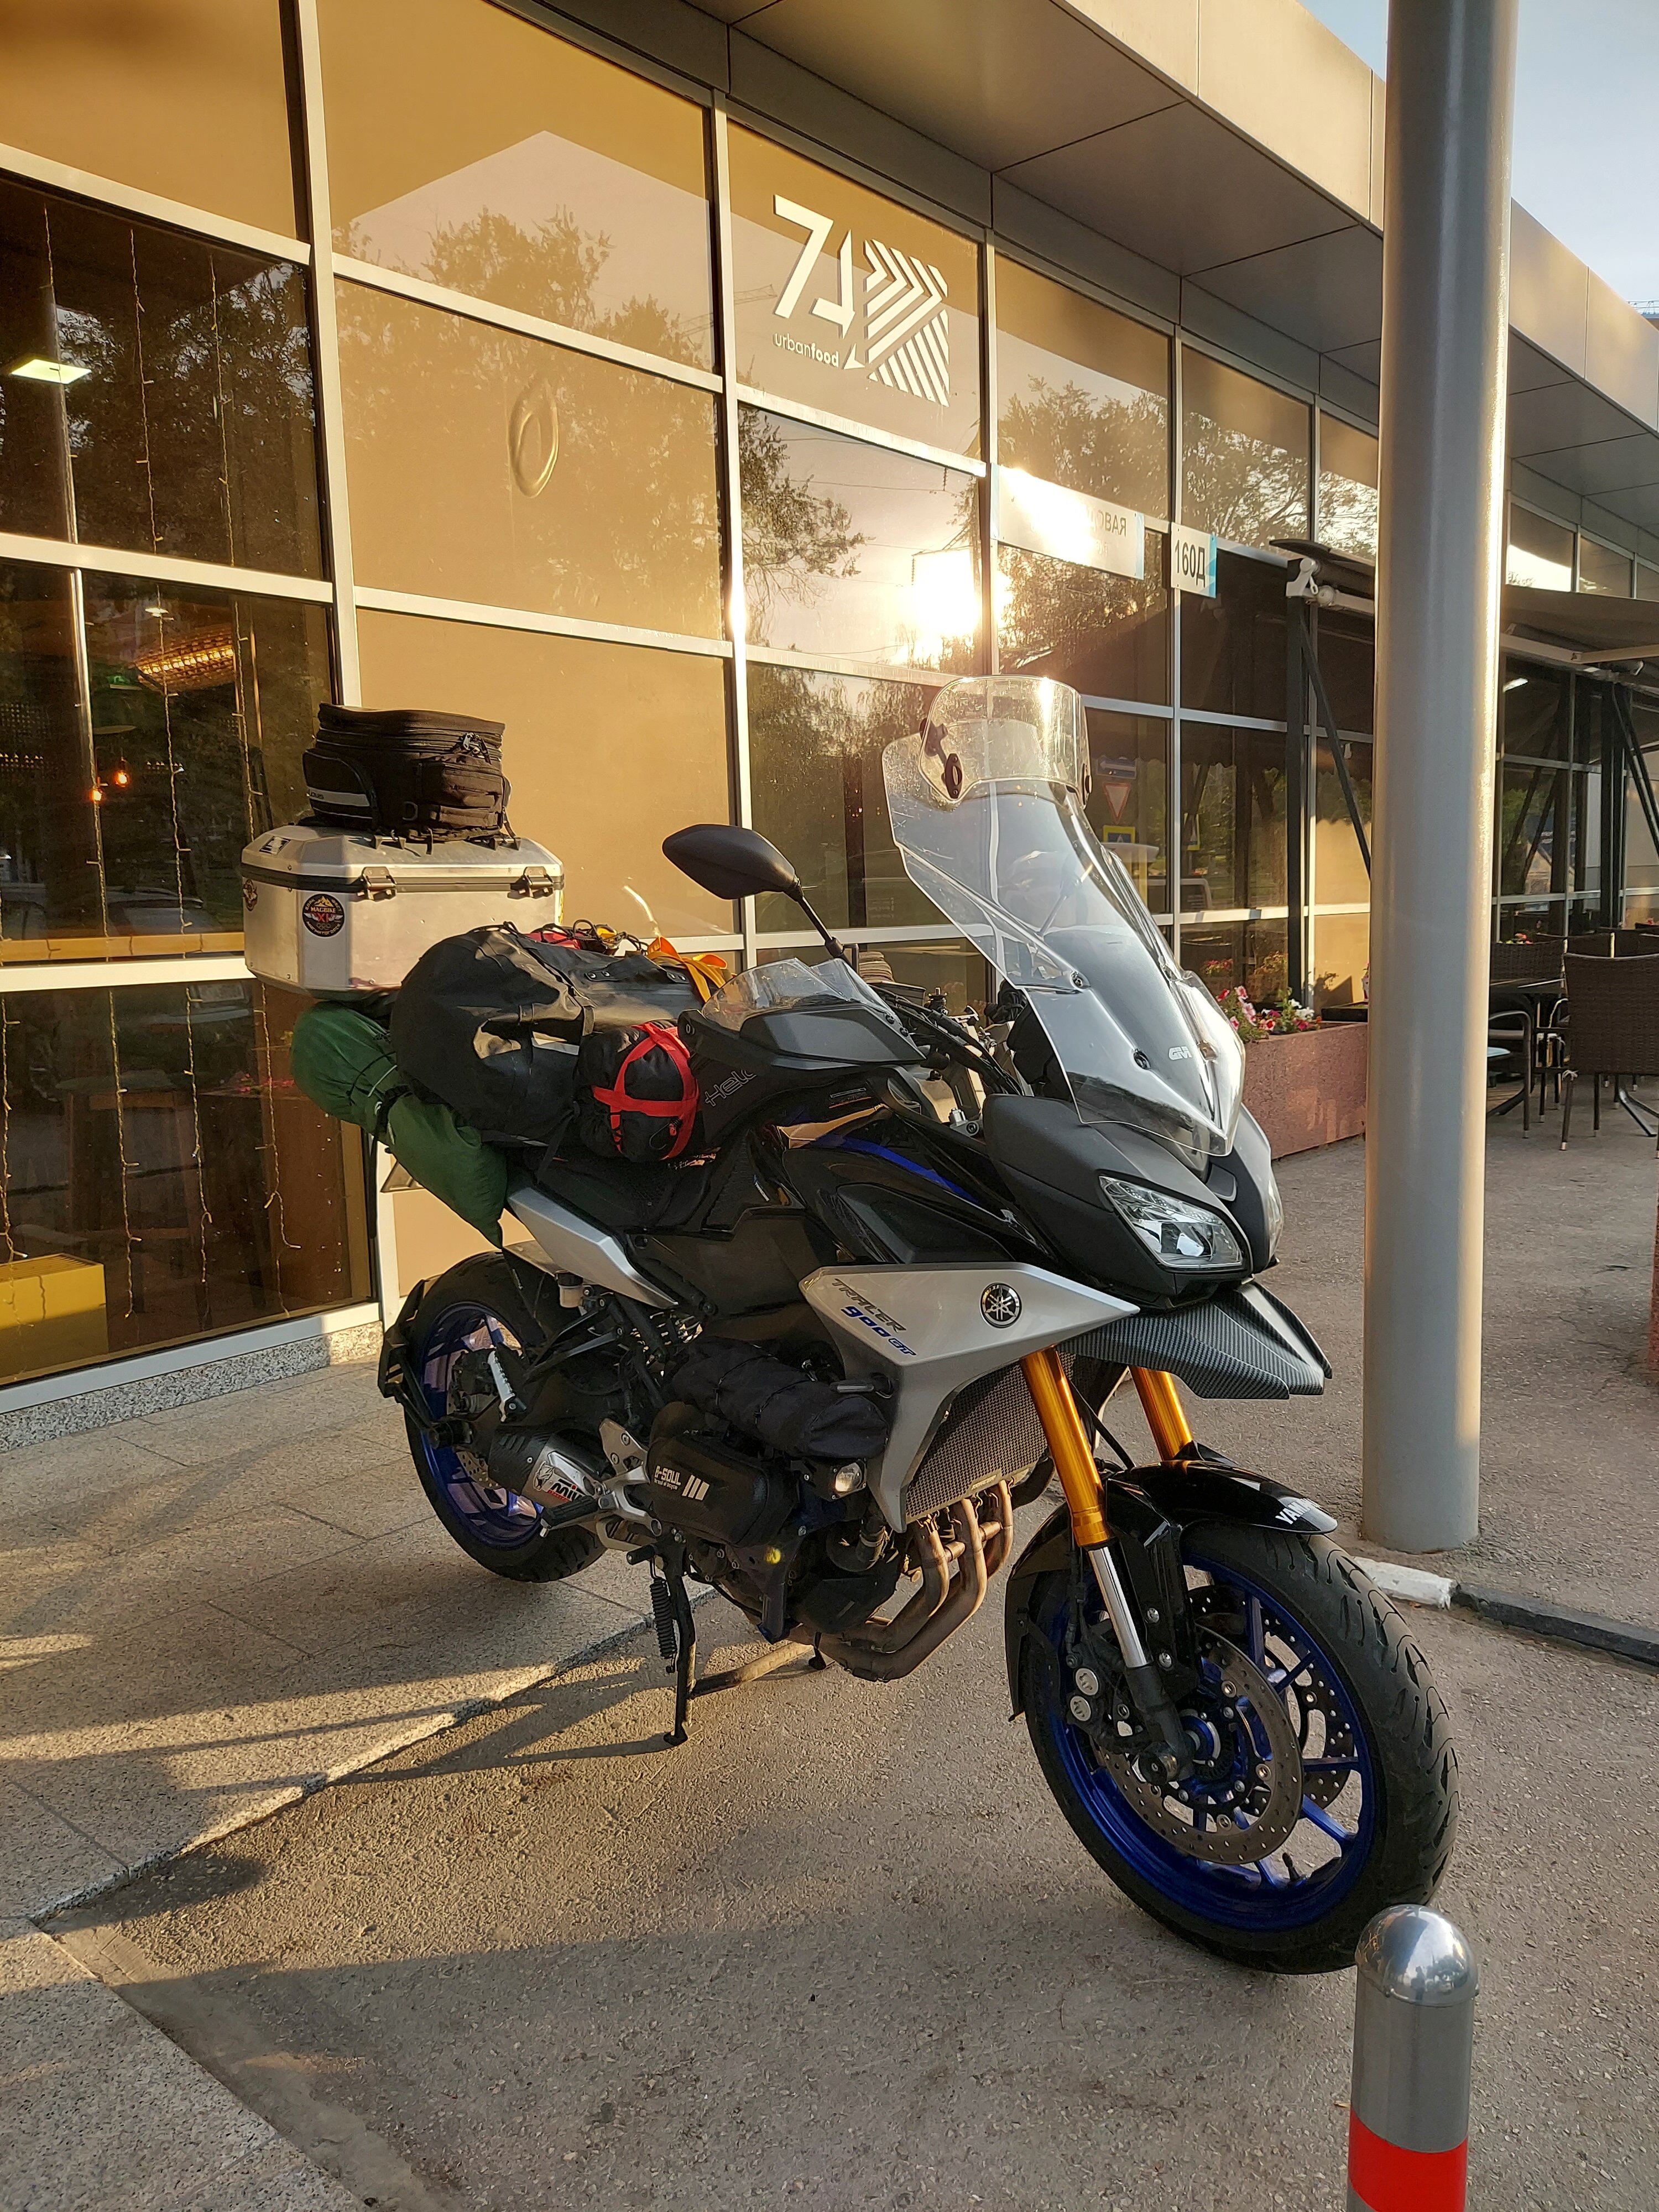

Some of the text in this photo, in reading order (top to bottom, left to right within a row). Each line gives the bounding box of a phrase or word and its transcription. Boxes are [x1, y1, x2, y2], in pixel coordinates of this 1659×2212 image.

[775, 333, 839, 368] urbanfood
[1175, 539, 1206, 588] 160Д
[832, 1278, 907, 1334] TRACER
[841, 1306, 917, 1356] 900 GT
